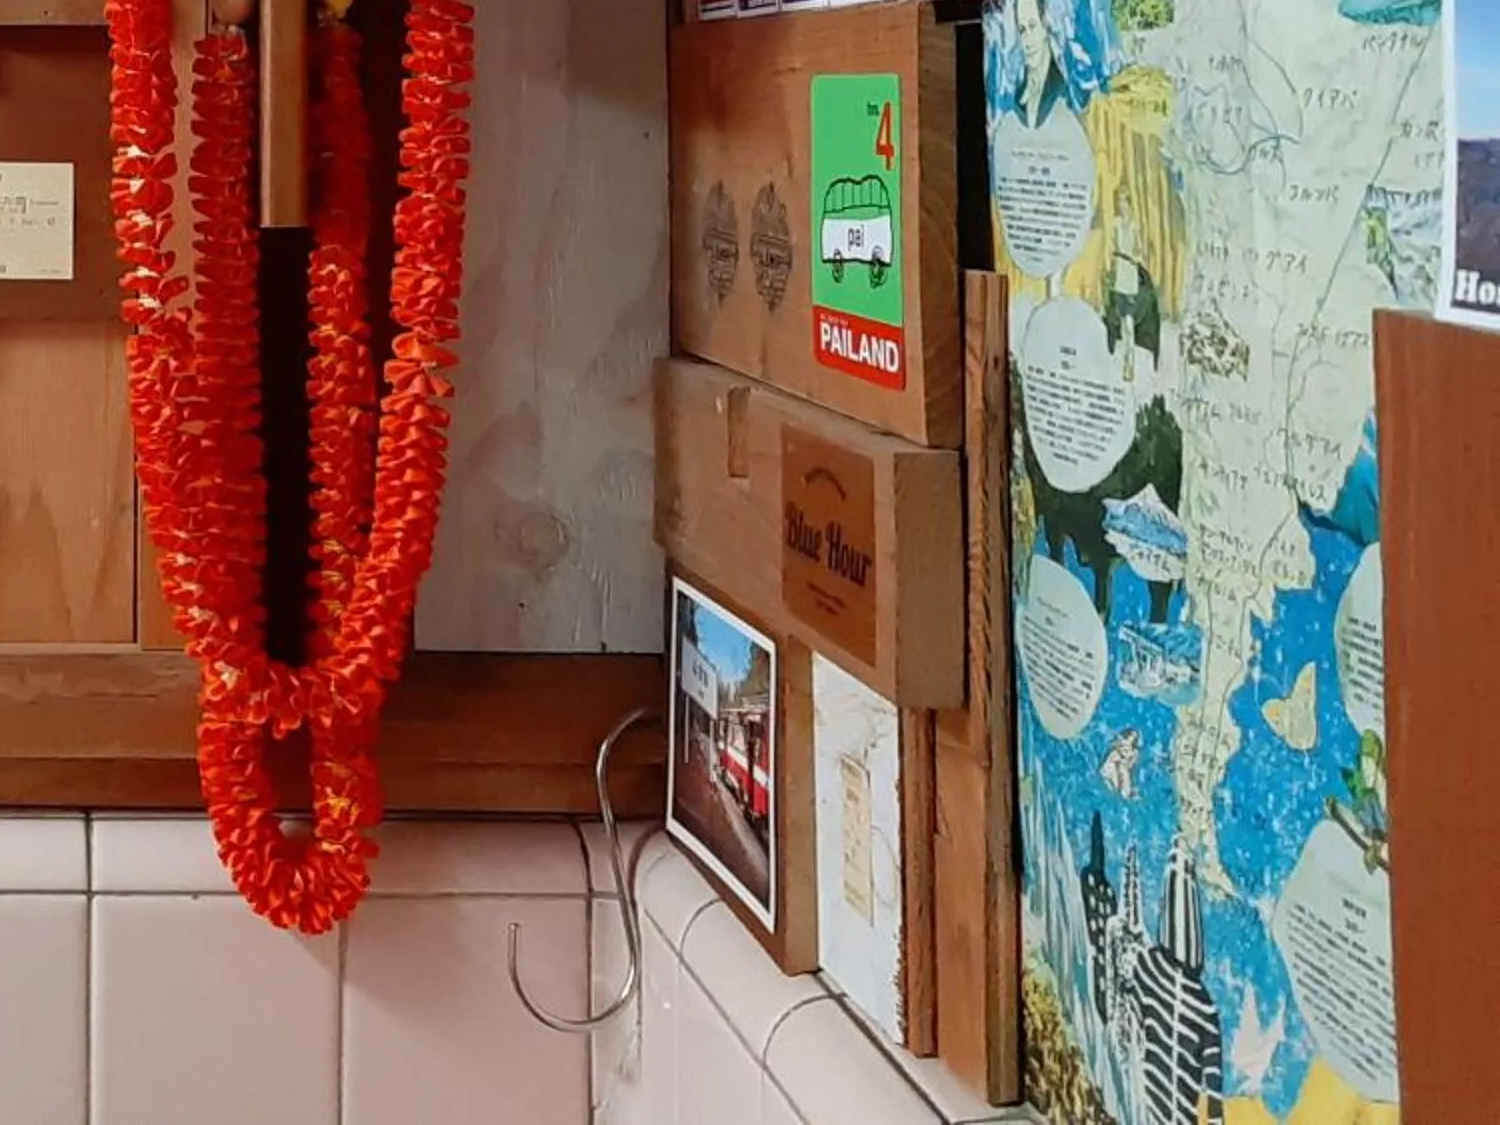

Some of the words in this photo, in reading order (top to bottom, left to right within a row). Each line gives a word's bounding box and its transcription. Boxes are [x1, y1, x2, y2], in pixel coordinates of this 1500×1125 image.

[875, 101, 895, 172] 4
[1455, 268, 1500, 306] Ho
[820, 321, 899, 373] PAILAND
[784, 499, 822, 563] Blue
[825, 521, 872, 588] Hour
